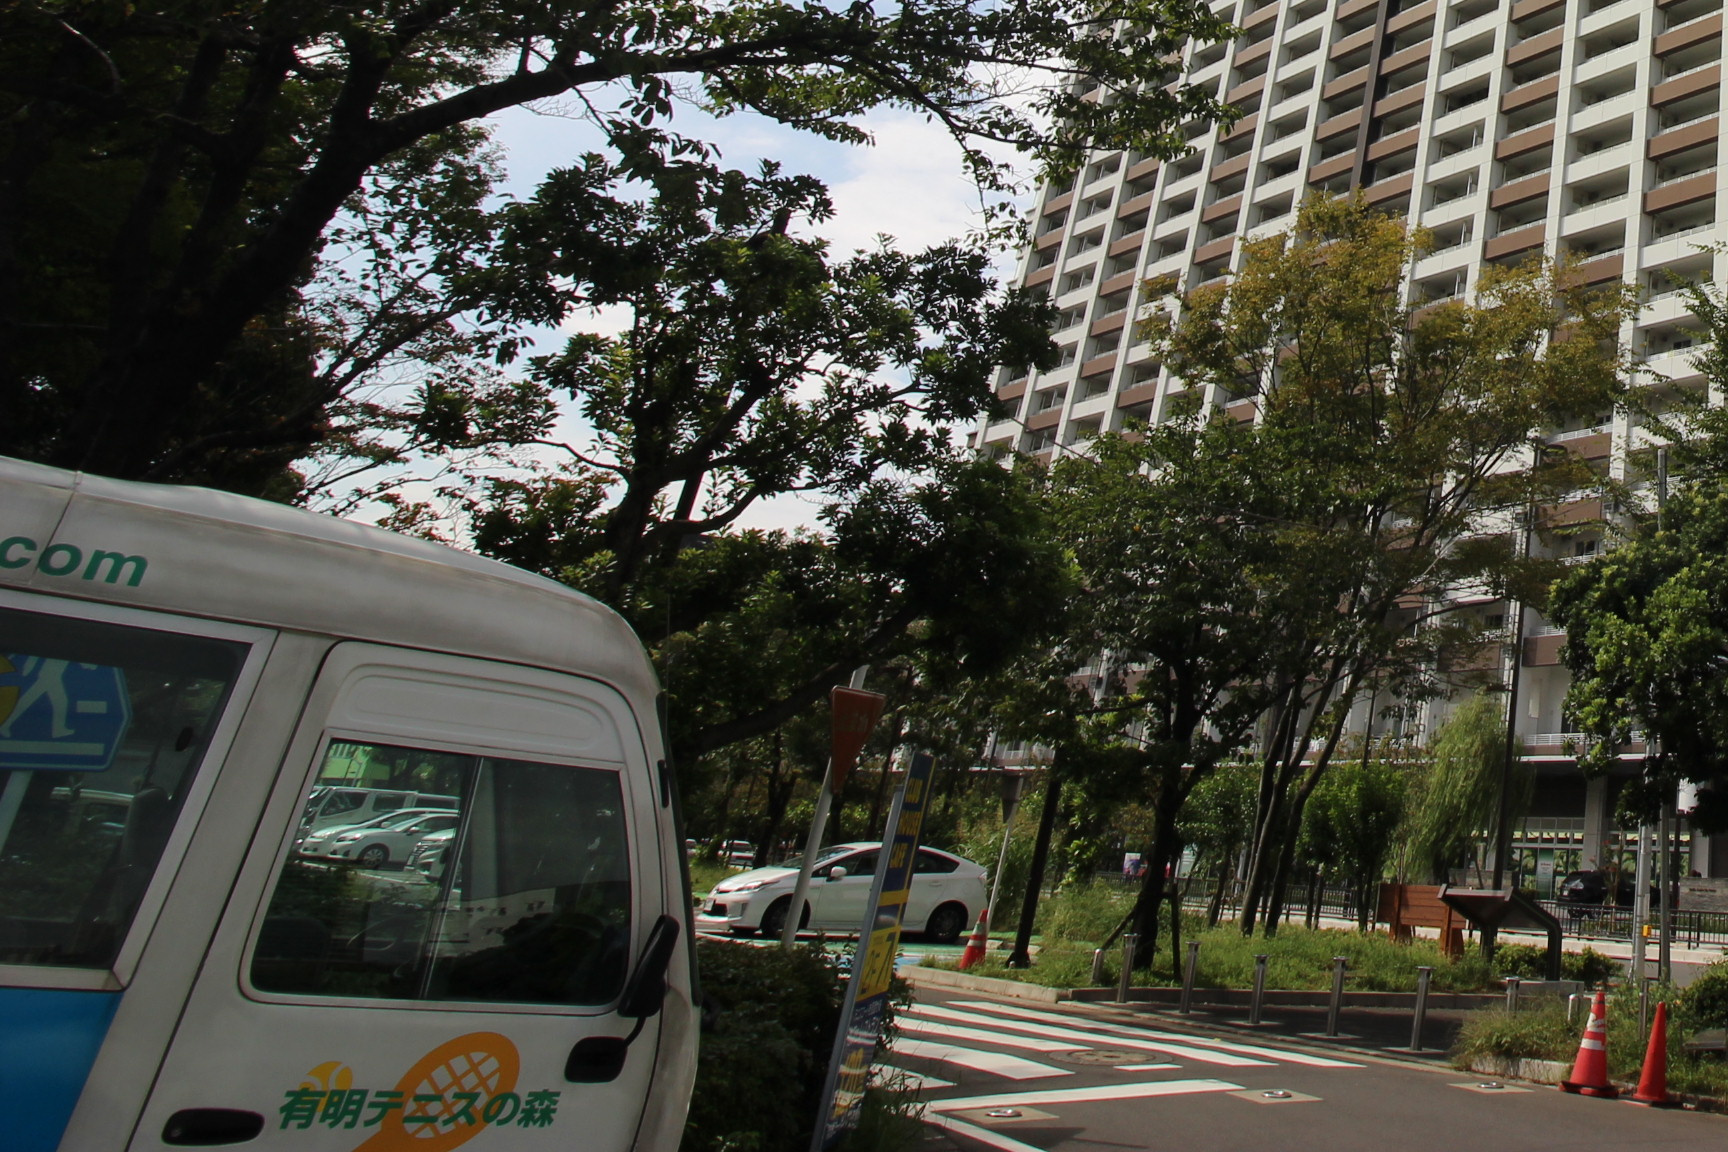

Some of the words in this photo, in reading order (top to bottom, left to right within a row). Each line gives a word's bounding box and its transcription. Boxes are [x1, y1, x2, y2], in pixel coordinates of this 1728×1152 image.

[279, 1087, 561, 1130] 有明テニスの森
